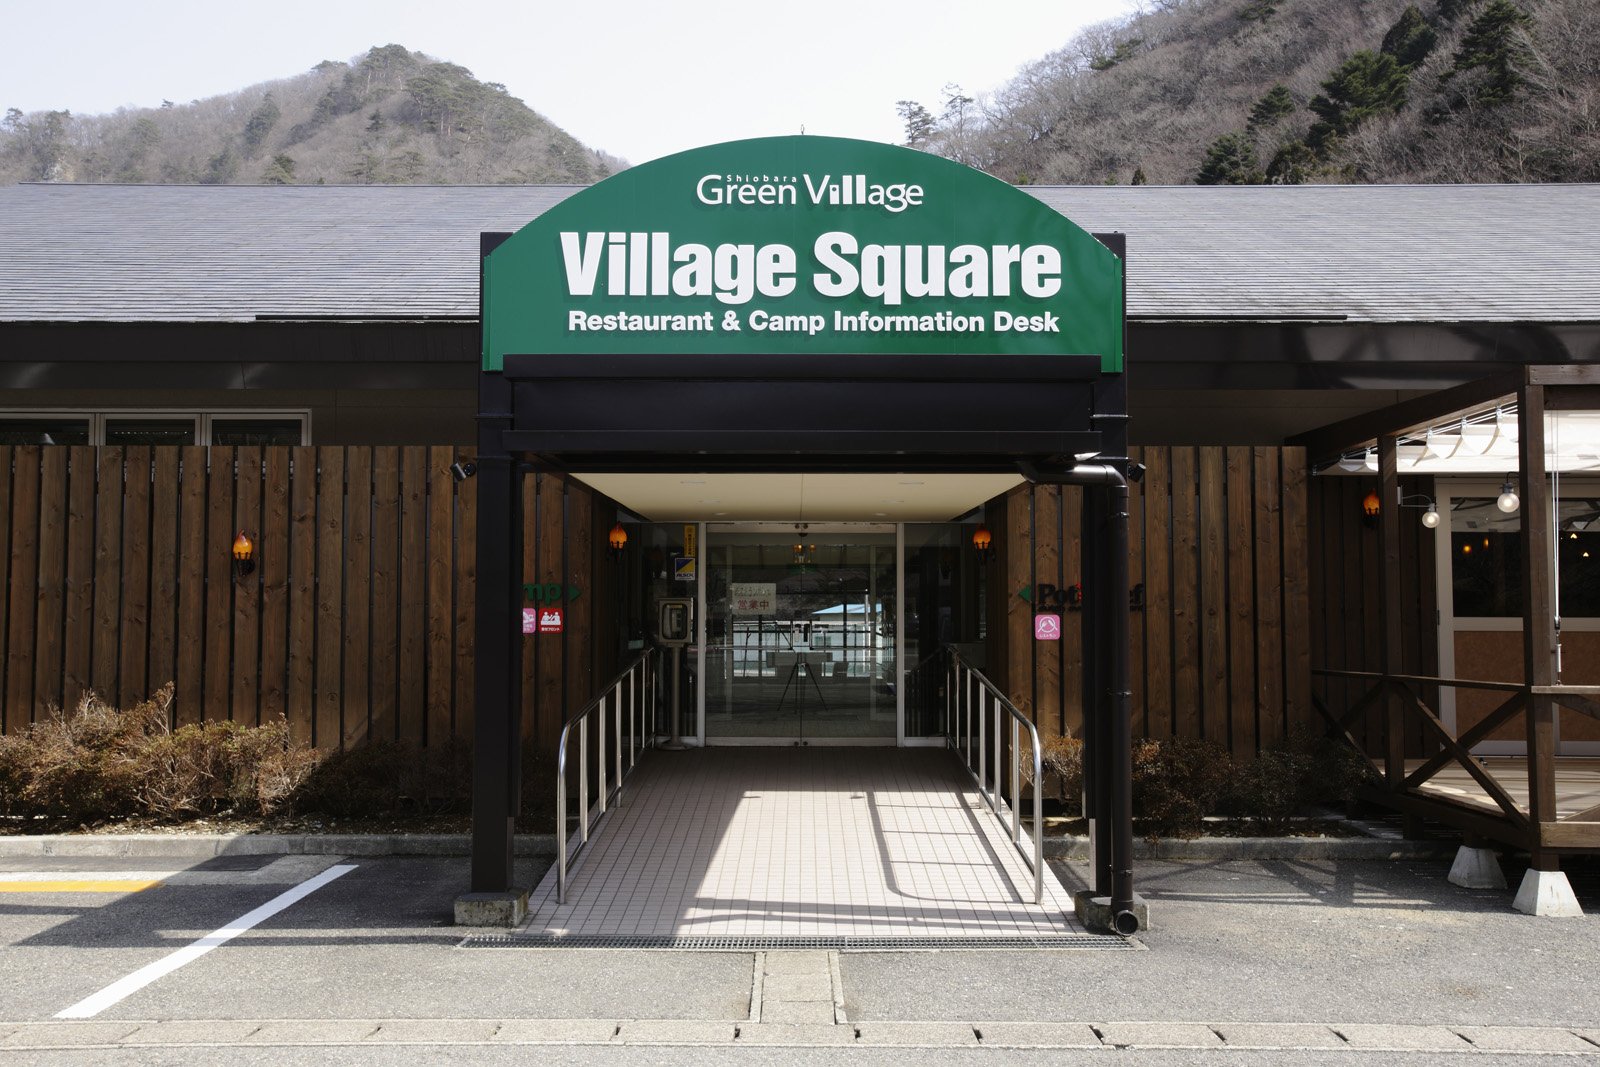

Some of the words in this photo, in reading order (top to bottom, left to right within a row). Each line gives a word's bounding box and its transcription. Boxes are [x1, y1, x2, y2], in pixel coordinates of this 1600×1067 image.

[726, 174, 797, 183] Shiobara
[696, 174, 797, 206] Green
[803, 174, 924, 213] Village
[559, 231, 797, 306] Village
[813, 231, 1063, 306] Square
[568, 310, 714, 332] Restaurant
[721, 310, 742, 332] &
[748, 310, 826, 336] Camp
[834, 310, 985, 332] Information
[994, 310, 1060, 333] Desk
[737, 599, 770, 611] 営業中
